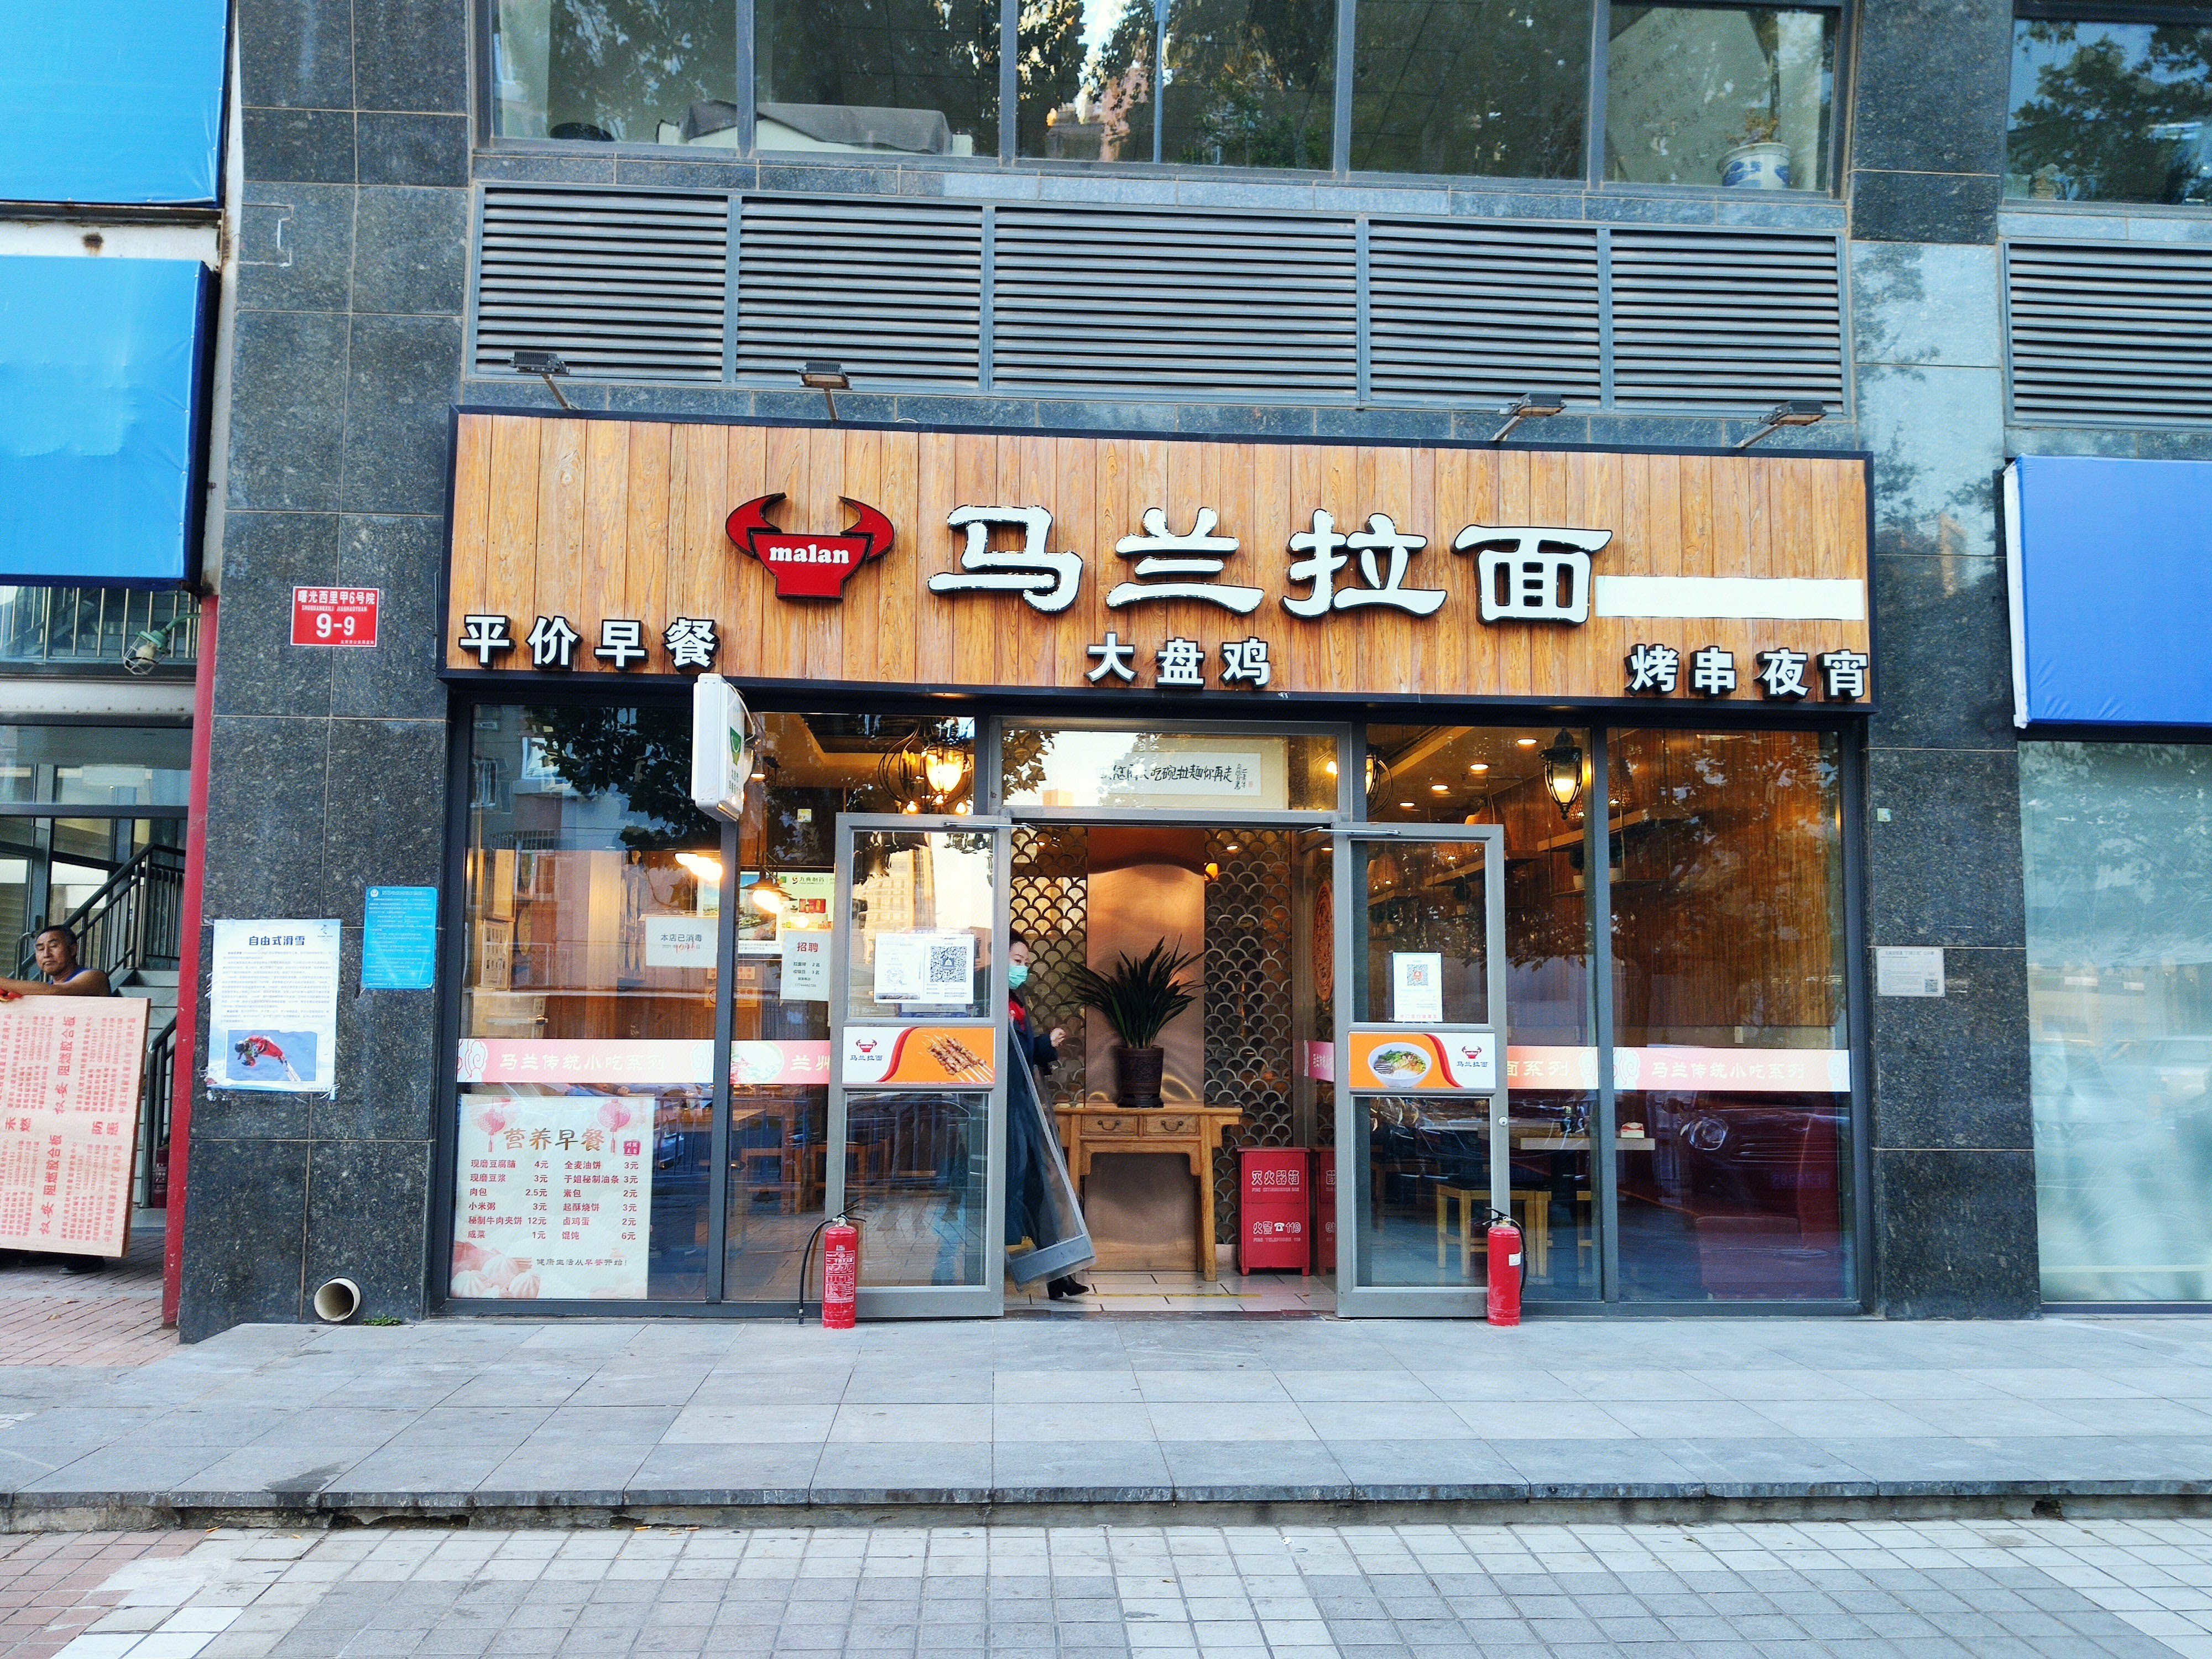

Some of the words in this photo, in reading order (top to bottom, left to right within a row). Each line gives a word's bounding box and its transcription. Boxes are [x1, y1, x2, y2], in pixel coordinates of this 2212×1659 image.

[769, 543, 851, 565] malan
[927, 504, 1612, 624] 马兰拉面
[298, 590, 375, 604] 曙光西里甲6号院
[316, 613, 355, 638] 9-9
[458, 614, 718, 669] 平价早餐
[1086, 632, 1271, 688] 大盘鸡
[1627, 642, 1869, 700] 烤串夜宵
[249, 936, 305, 946] 自由式滑雪
[660, 933, 702, 942] 本店已消毒
[797, 942, 818, 952] 招聘
[57, 1016, 75, 1076] 阻燃胶合板
[499, 1053, 665, 1071] 马兰传统小吃系列
[1651, 1061, 1805, 1079] 马兰传统小吃系列
[504, 1128, 605, 1151] 营养早餐
[43, 1135, 62, 1196] 阻燃胶合板
[471, 1160, 515, 1168] 现磨豆腐脑
[565, 1161, 601, 1170] 全麦油饼
[1251, 1170, 1300, 1185] 灭火器箱
[469, 1188, 487, 1196] 肉包
[468, 1217, 522, 1225] 秘制牛肉夹饼
[563, 1217, 589, 1225] 卤鸡蛋
[1253, 1221, 1273, 1234] 火警
[1286, 1222, 1301, 1233] 119
[562, 1232, 580, 1240] 馄饨
